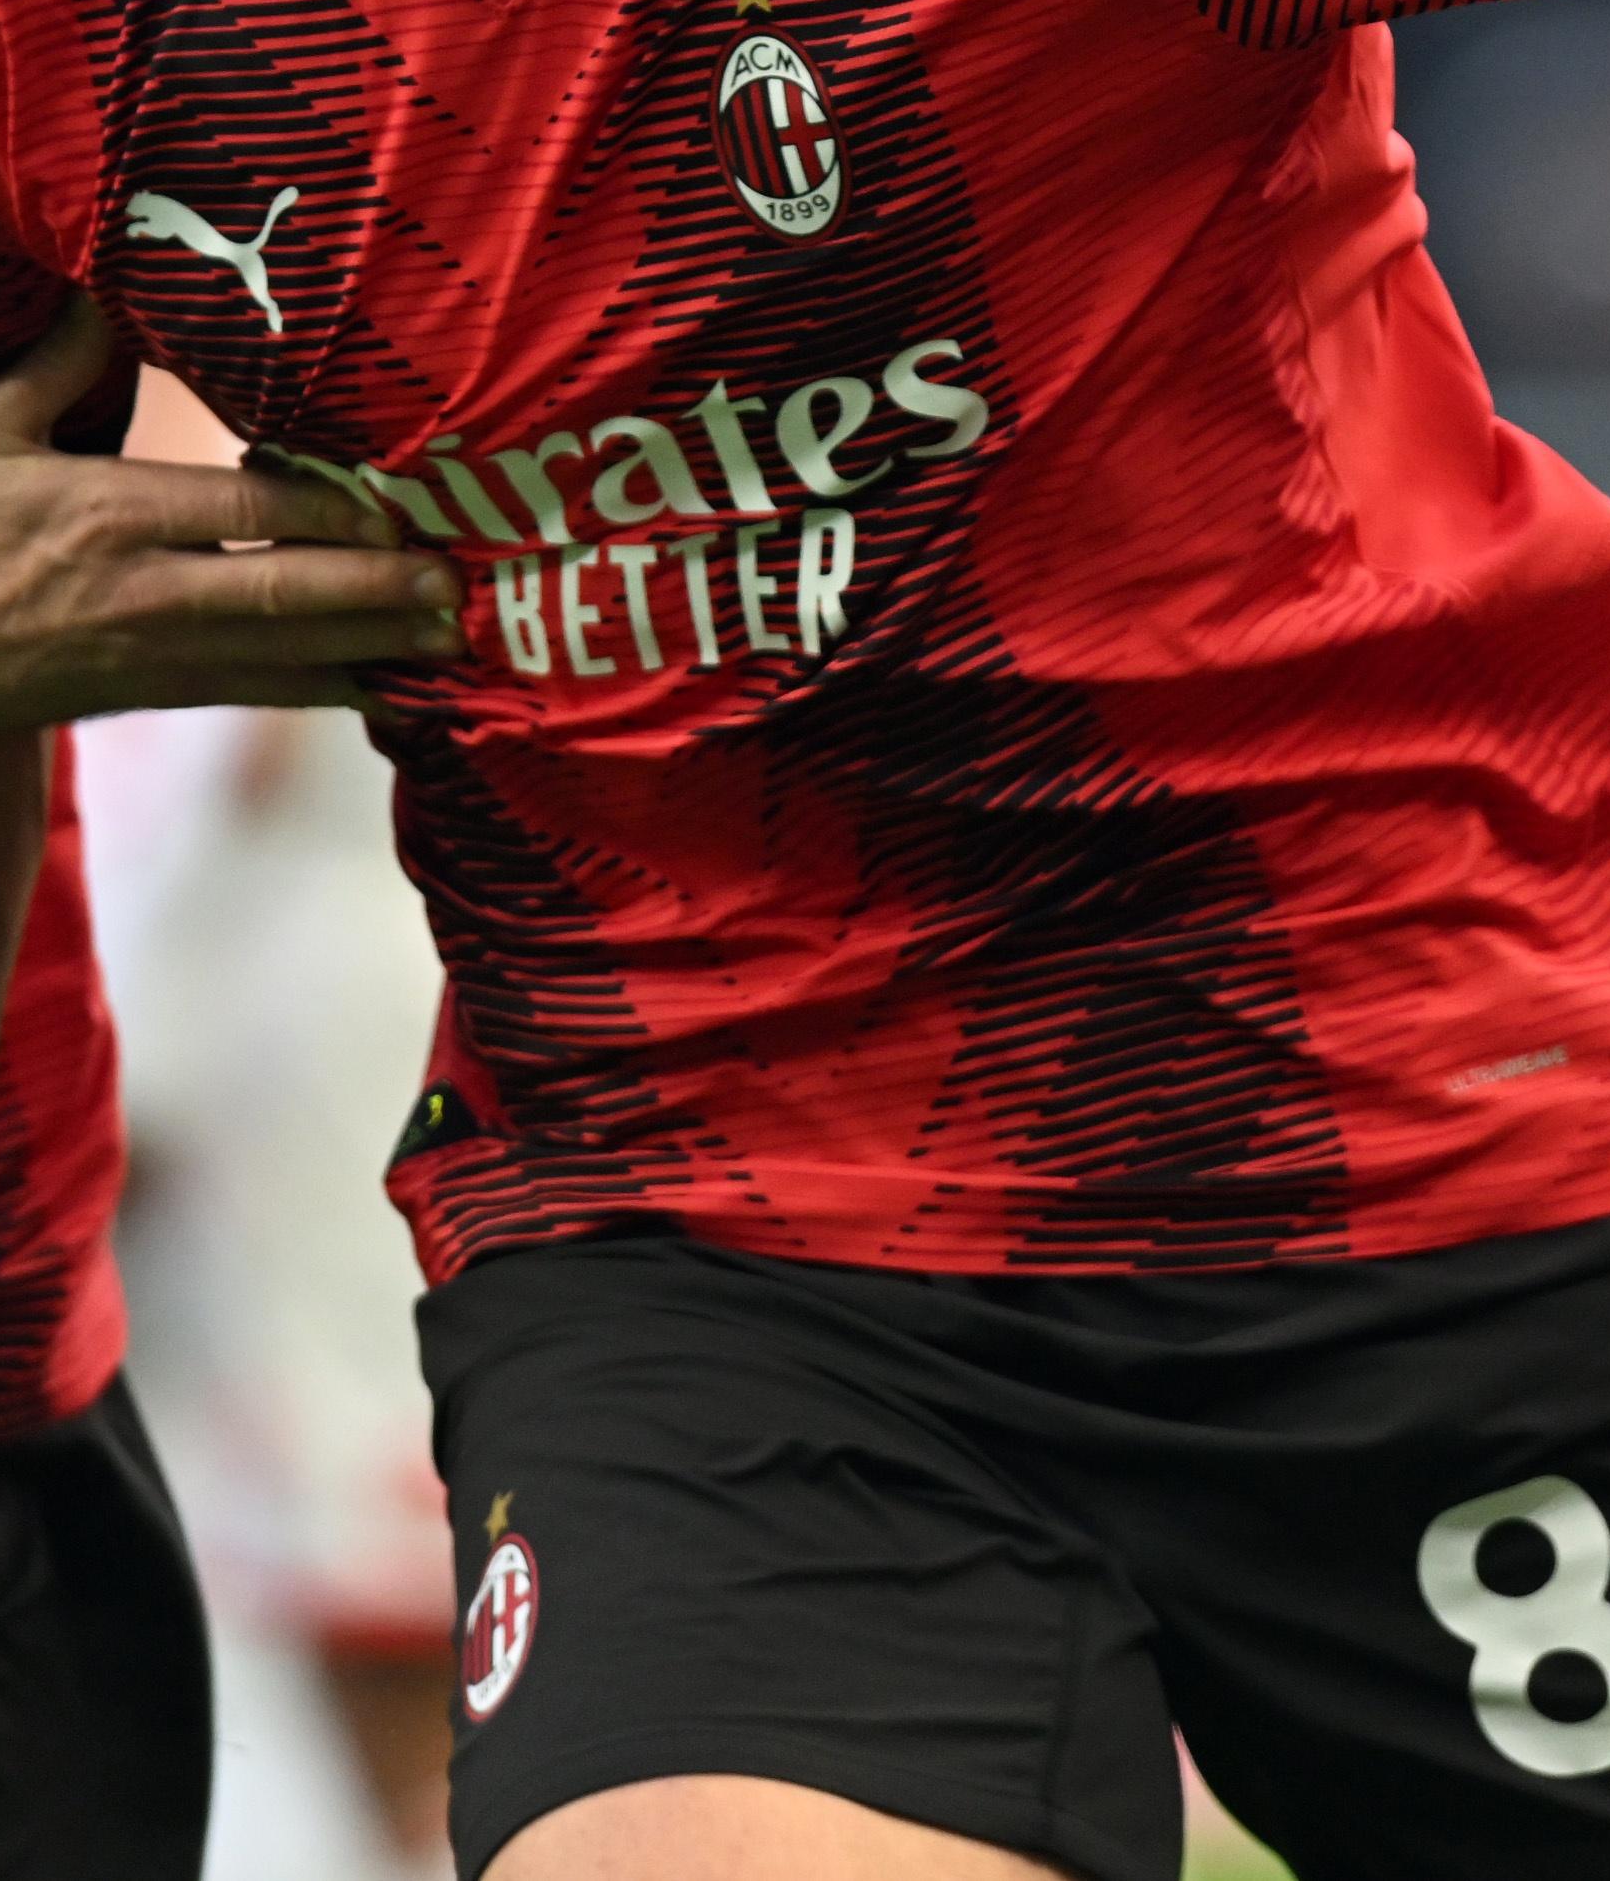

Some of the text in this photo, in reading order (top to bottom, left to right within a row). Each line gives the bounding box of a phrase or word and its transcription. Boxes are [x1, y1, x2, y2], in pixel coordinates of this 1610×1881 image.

[731, 42, 800, 86] ACM
[765, 193, 831, 222] 1899
[494, 508, 855, 678] BETTER
